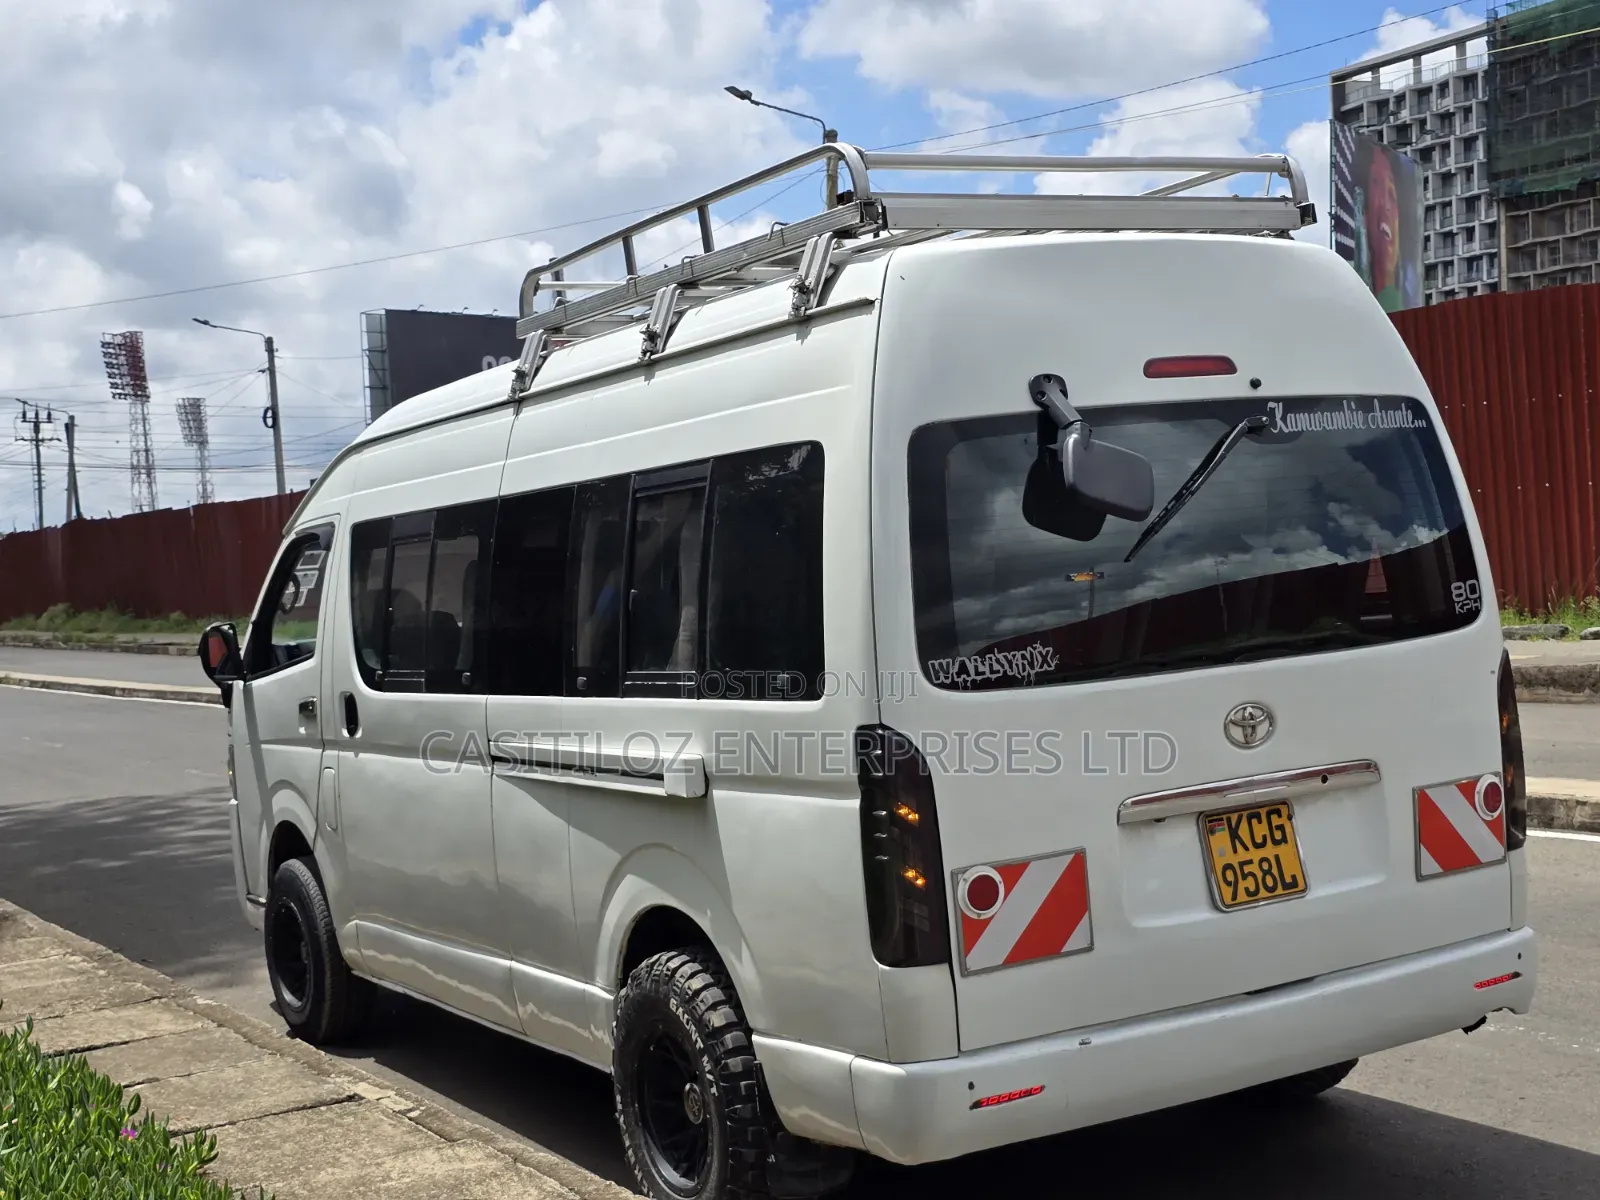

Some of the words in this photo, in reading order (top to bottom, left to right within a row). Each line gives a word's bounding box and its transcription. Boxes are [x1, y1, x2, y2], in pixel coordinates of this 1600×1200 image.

[1267, 400, 1366, 434] Kamwambie
[1450, 579, 1480, 602] 80
[1454, 599, 1481, 615] KPH
[927, 642, 1057, 686] WALLYNX
[1226, 807, 1289, 855] KCG
[1221, 853, 1299, 902] 958L
